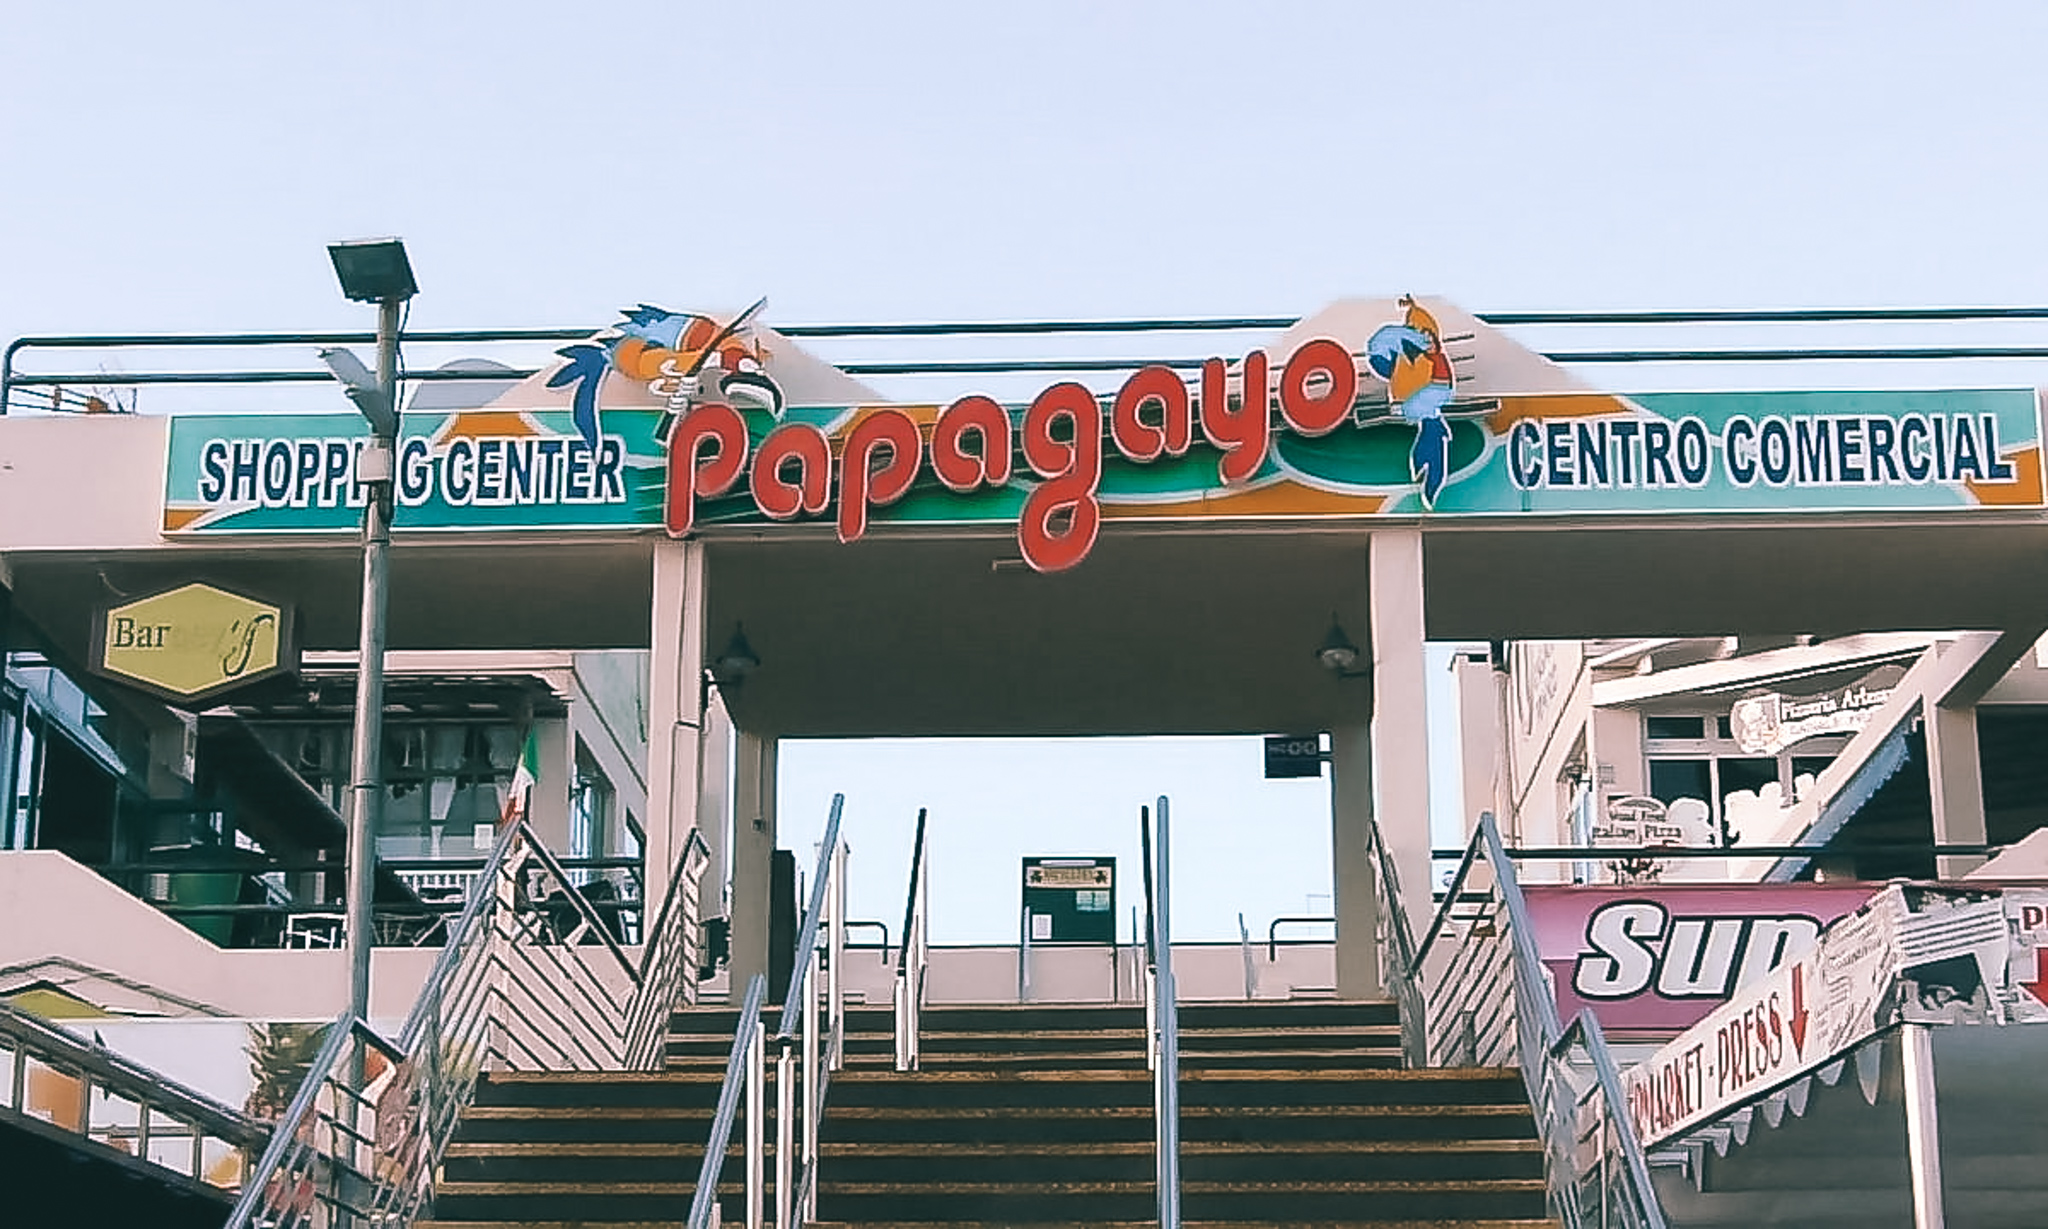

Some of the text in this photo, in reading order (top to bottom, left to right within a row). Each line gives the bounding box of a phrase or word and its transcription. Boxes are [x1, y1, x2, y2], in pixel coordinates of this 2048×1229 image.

[199, 436, 625, 506] SHOPPIG CENTER
[1508, 414, 2016, 489] CENTRO COMERCIAL
[113, 617, 171, 648] Bar
[1574, 901, 1822, 1000] Sup
[2021, 905, 2048, 931] P
[1717, 991, 1782, 1098] PRESS
